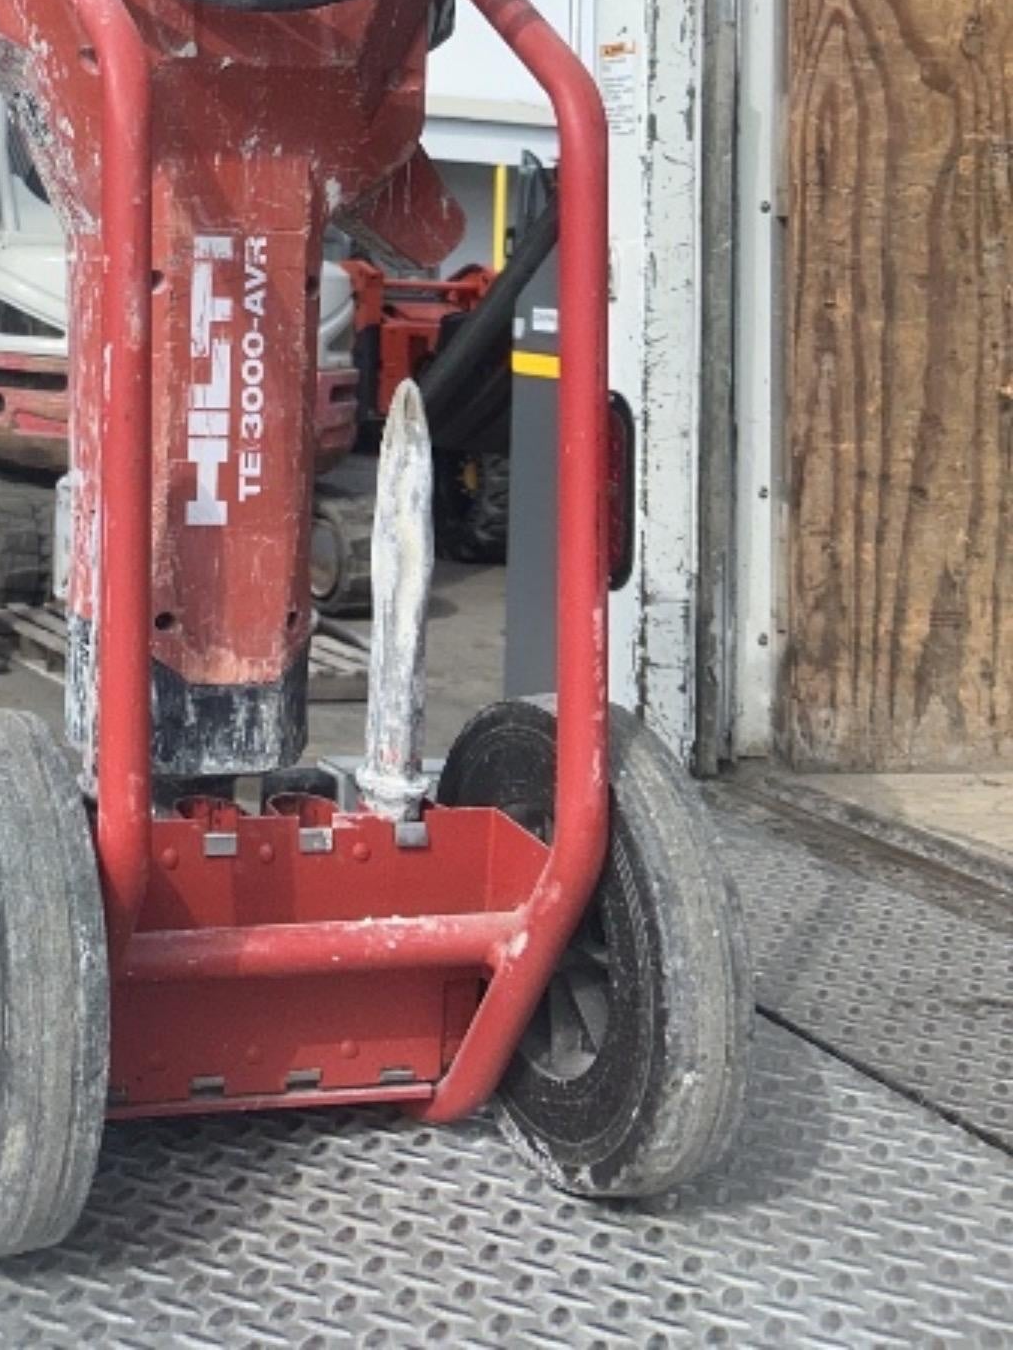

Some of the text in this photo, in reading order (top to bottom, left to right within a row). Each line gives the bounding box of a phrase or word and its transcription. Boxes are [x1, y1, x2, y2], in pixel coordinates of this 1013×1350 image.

[185, 235, 233, 526] HILTI
[238, 236, 267, 502] TE 3000-AVR
